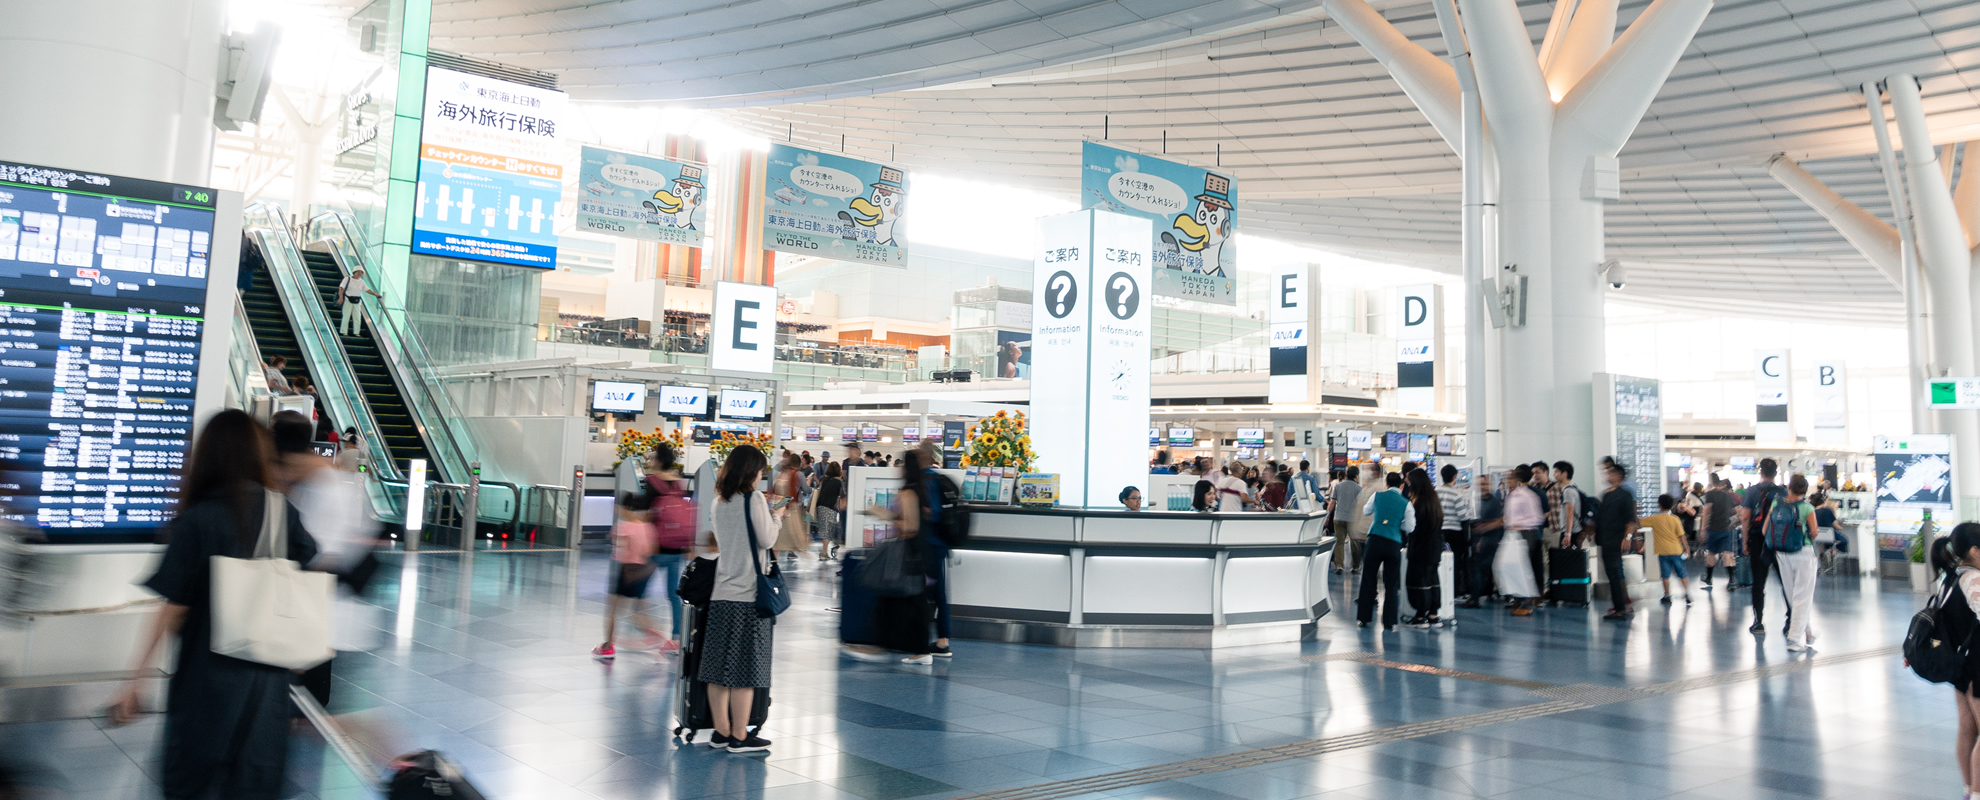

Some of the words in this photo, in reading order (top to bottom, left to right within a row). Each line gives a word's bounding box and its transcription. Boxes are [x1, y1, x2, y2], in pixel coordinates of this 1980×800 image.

[476, 88, 540, 108] 東京海上日動
[437, 100, 556, 138] 海外旅行保険
[800, 168, 833, 180] 今すぐ空港の
[1118, 176, 1155, 192] 今すぐ空港の
[588, 222, 625, 232] WORLD
[776, 238, 818, 250] WORLD
[856, 244, 887, 252] HANEDA
[856, 248, 888, 258] TOKYO
[856, 254, 888, 262] JAPAN
[1044, 246, 1079, 263] ご案内
[1106, 247, 1142, 266] ご案内
[193, 264, 202, 276] A
[1182, 275, 1215, 285] HANEDA
[1182, 282, 1216, 292] TOKYO
[1281, 274, 1298, 308] E
[1182, 289, 1216, 298] JAPAN
[1404, 296, 1427, 326] D
[732, 299, 760, 350] E
[1039, 324, 1080, 334] Information
[1100, 325, 1144, 337] Information
[1274, 331, 1292, 340] ANA
[1400, 346, 1420, 356] ANA
[1762, 356, 1780, 378] C
[1820, 366, 1836, 386] B
[604, 392, 625, 401] ANA
[668, 396, 689, 405] ANA
[729, 400, 748, 408] ANA
[1304, 430, 1312, 445] E
